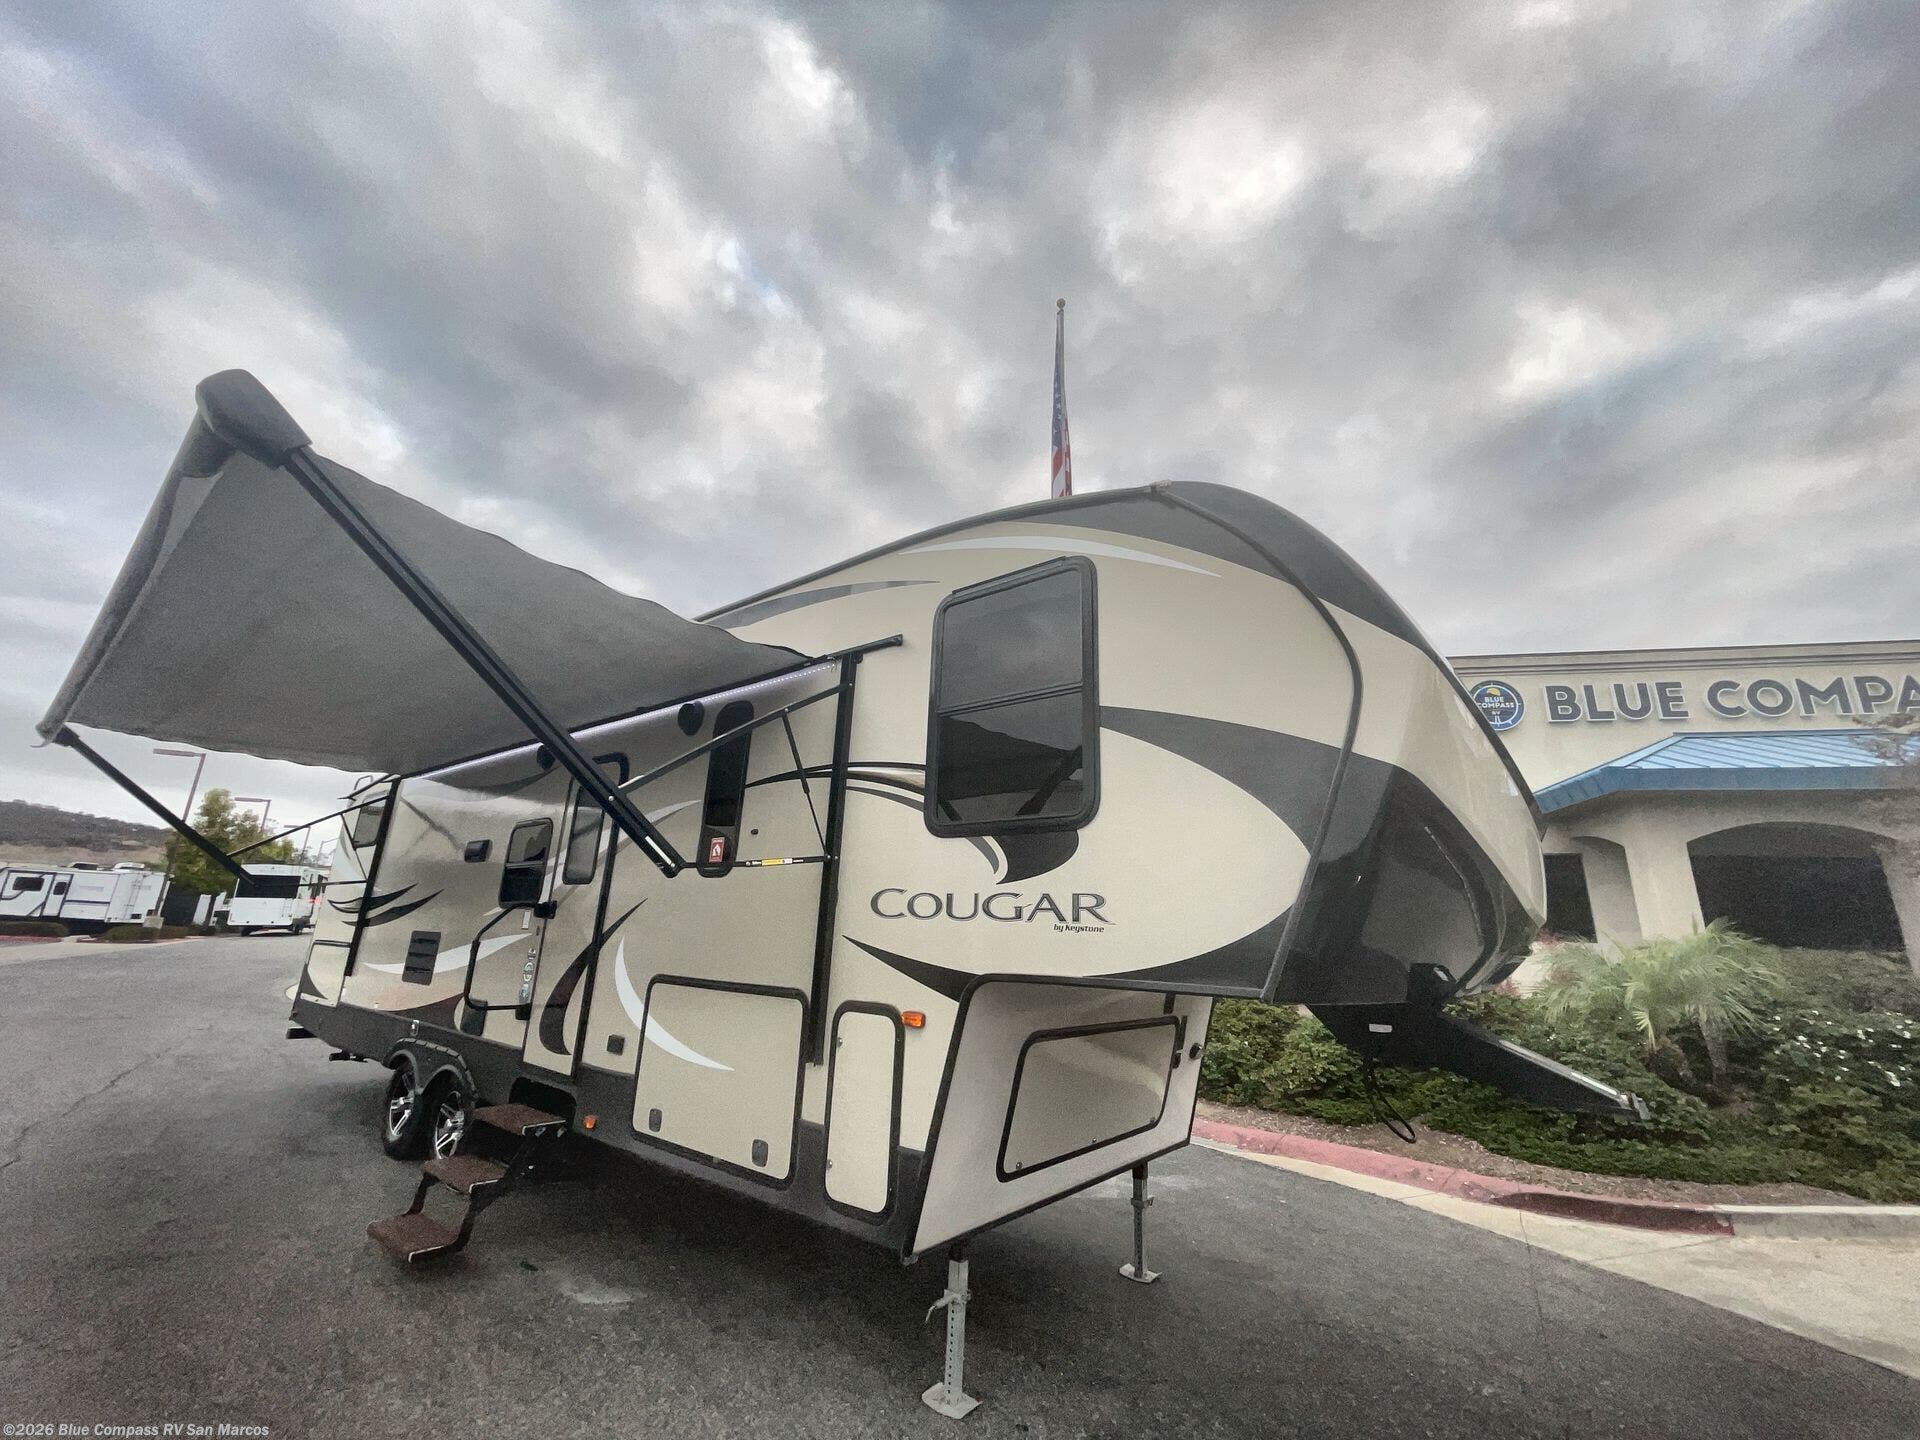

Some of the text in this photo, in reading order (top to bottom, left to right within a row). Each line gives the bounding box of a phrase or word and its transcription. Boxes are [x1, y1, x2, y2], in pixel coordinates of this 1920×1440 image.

[1546, 675, 1920, 723] BLUE COMPA
[870, 887, 1117, 925] COUGAR
[1053, 924, 1105, 933] by Keystone
